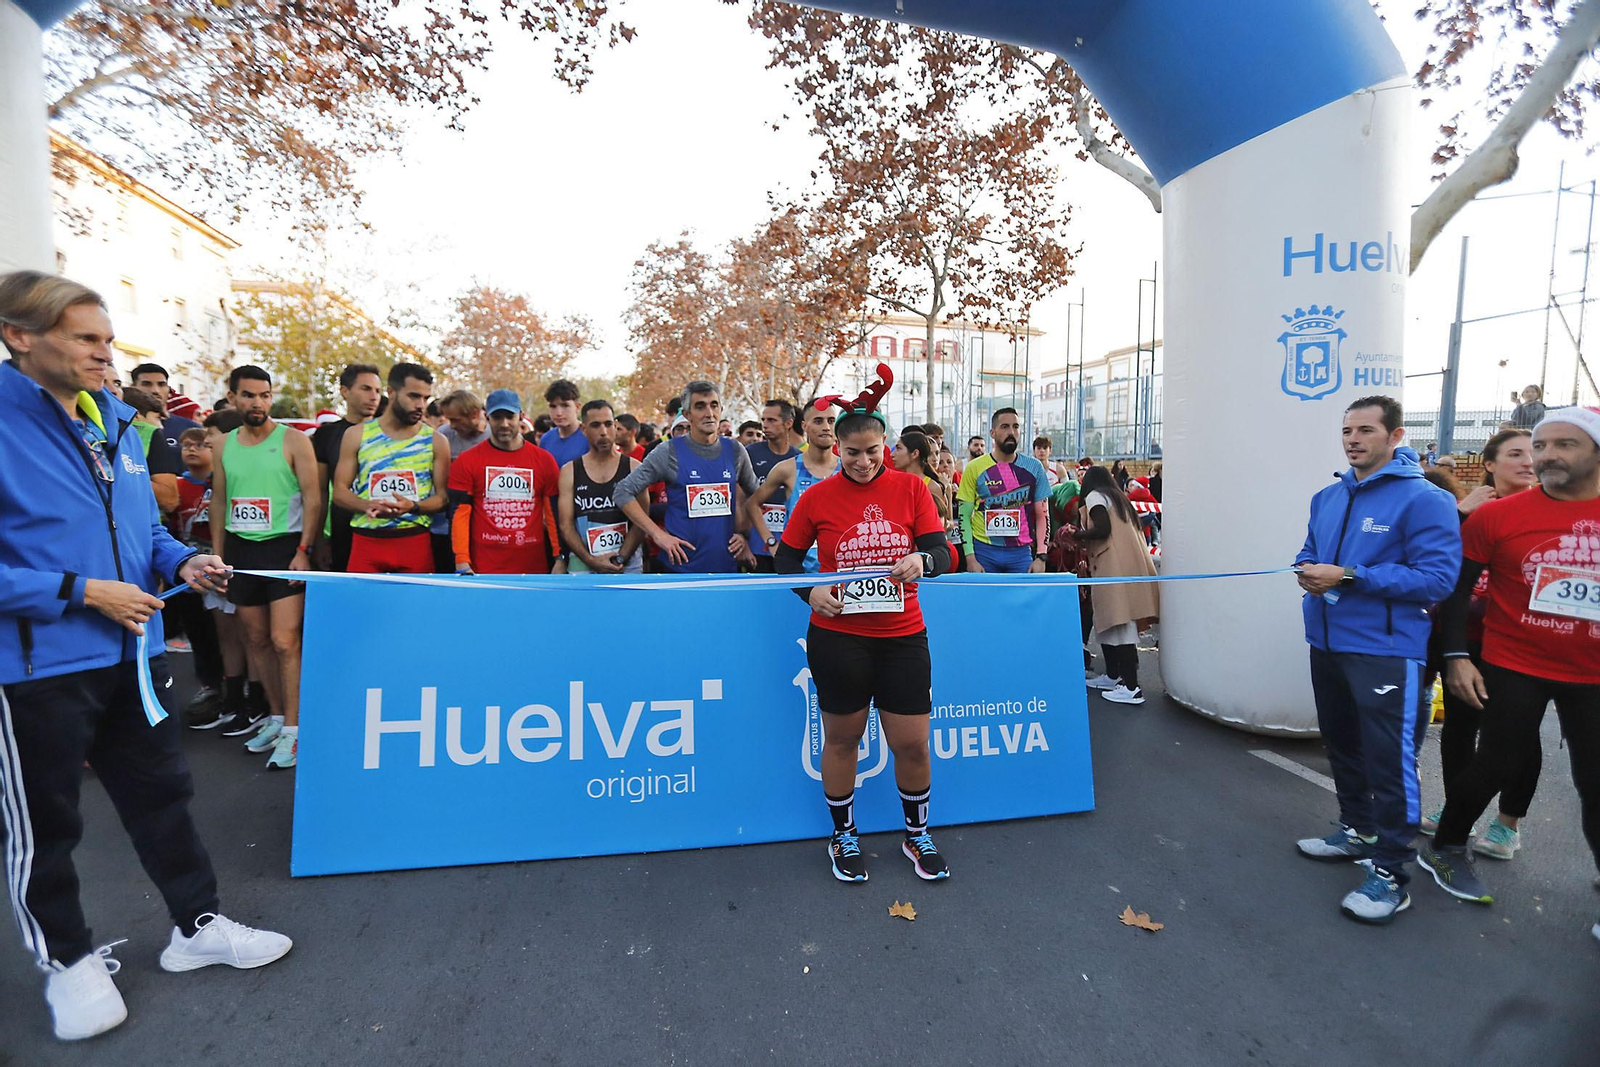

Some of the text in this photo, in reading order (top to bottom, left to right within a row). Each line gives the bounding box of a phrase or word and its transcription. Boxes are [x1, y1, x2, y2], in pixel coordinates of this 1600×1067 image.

[1283, 231, 1408, 277] Huelv
[381, 479, 406, 493] 645
[498, 476, 521, 489] 300
[699, 492, 720, 506] 533
[235, 507, 257, 520] 463
[767, 512, 786, 523] 333
[494, 517, 527, 529] 2023
[856, 520, 892, 535] XIII
[993, 517, 1012, 528] 613
[951, 527, 960, 537] 29
[599, 532, 620, 548] 532
[839, 532, 909, 552] CARRERA
[1558, 535, 1600, 550] XII
[836, 550, 861, 561] SAN
[854, 578, 887, 598] 396
[1556, 580, 1600, 604] 393
[1521, 613, 1574, 630] Huelva
[810, 693, 818, 719] MARIS
[929, 696, 1047, 719] untamiento de
[363, 681, 695, 769] Huelva
[928, 722, 1050, 760] UELVA
[586, 766, 696, 803] original
